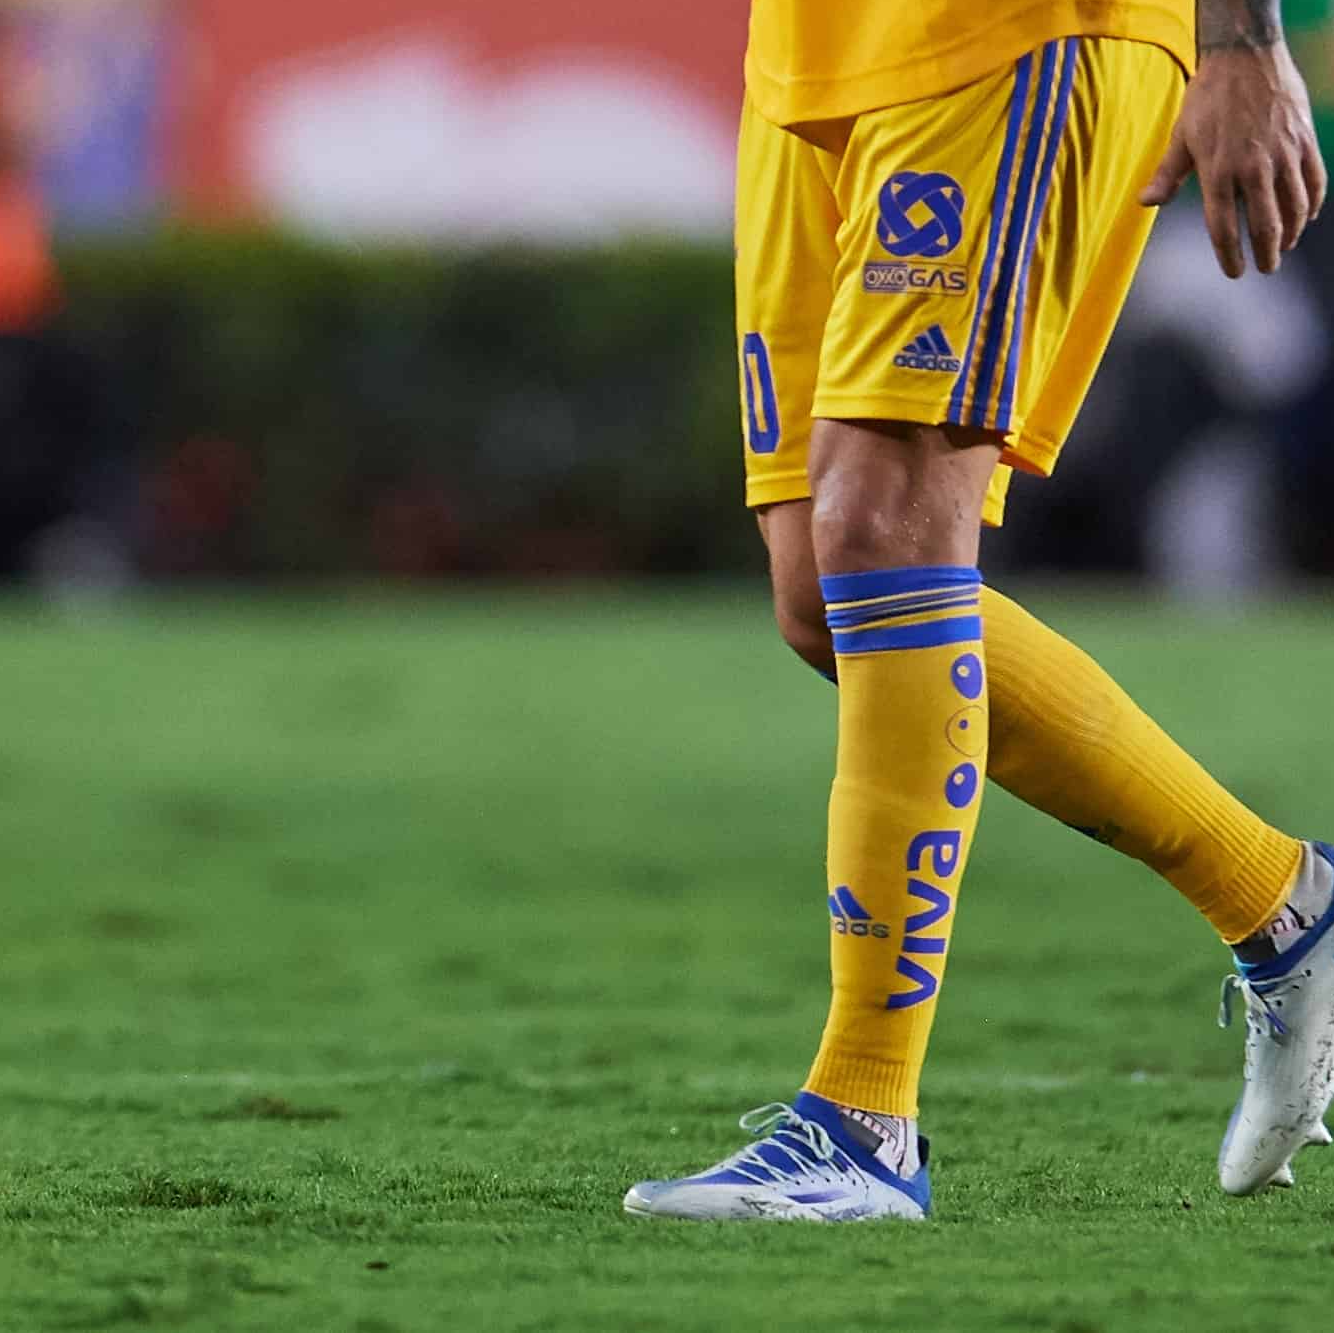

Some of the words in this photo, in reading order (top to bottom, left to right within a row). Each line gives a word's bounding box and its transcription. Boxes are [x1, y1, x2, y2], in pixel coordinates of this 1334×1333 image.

[893, 352, 961, 372] adidas
[834, 913, 890, 938] das
[886, 829, 963, 1010] viva
